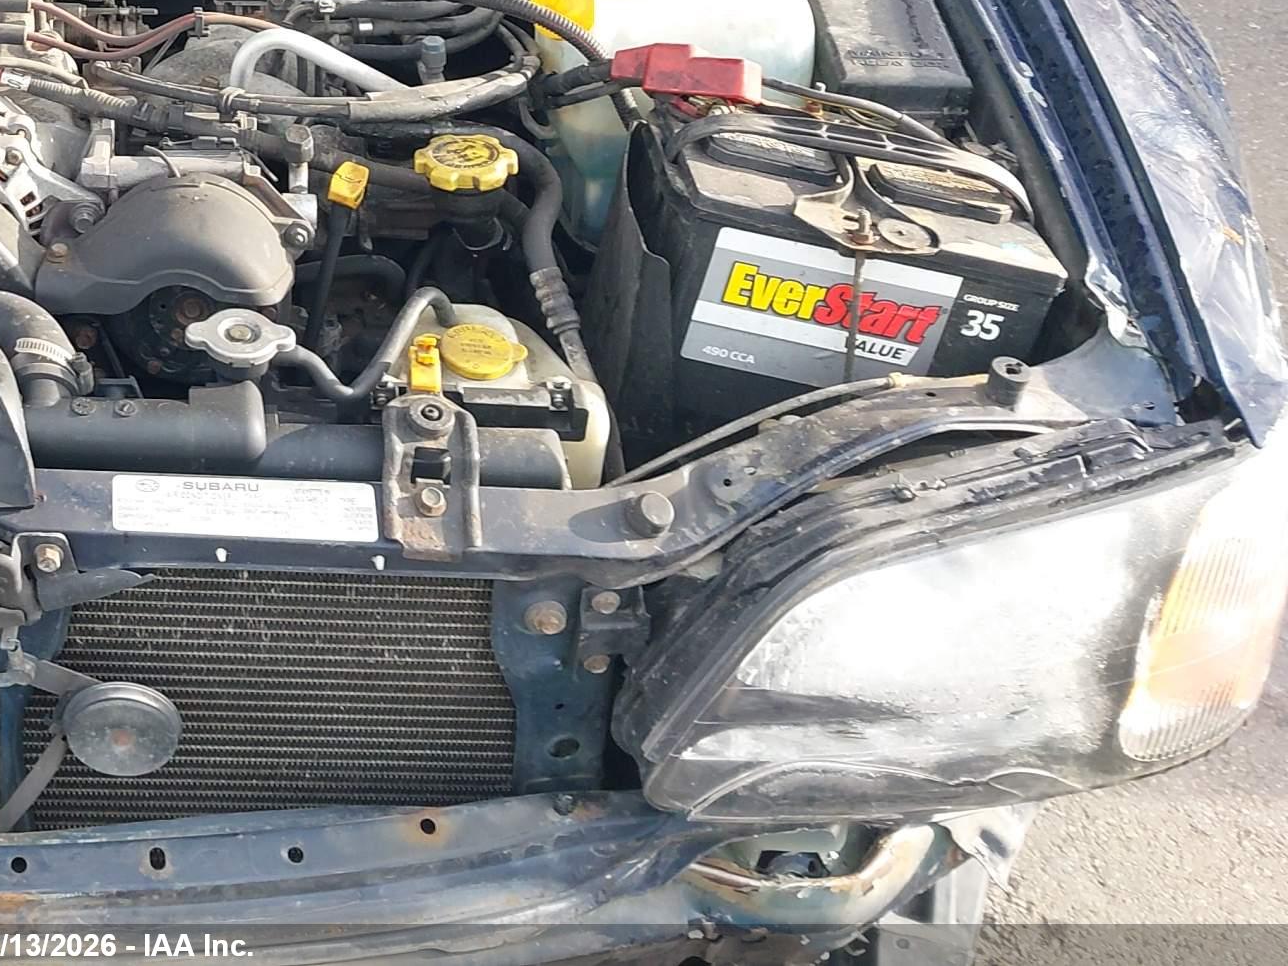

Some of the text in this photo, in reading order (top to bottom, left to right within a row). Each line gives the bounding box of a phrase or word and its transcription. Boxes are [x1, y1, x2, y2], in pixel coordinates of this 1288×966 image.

[722, 260, 944, 345] EverStart
[963, 293, 1020, 312] GROUP SIZE
[960, 309, 1005, 342] 35
[702, 345, 756, 365] 490 CCA
[182, 481, 260, 493] SUBARU
